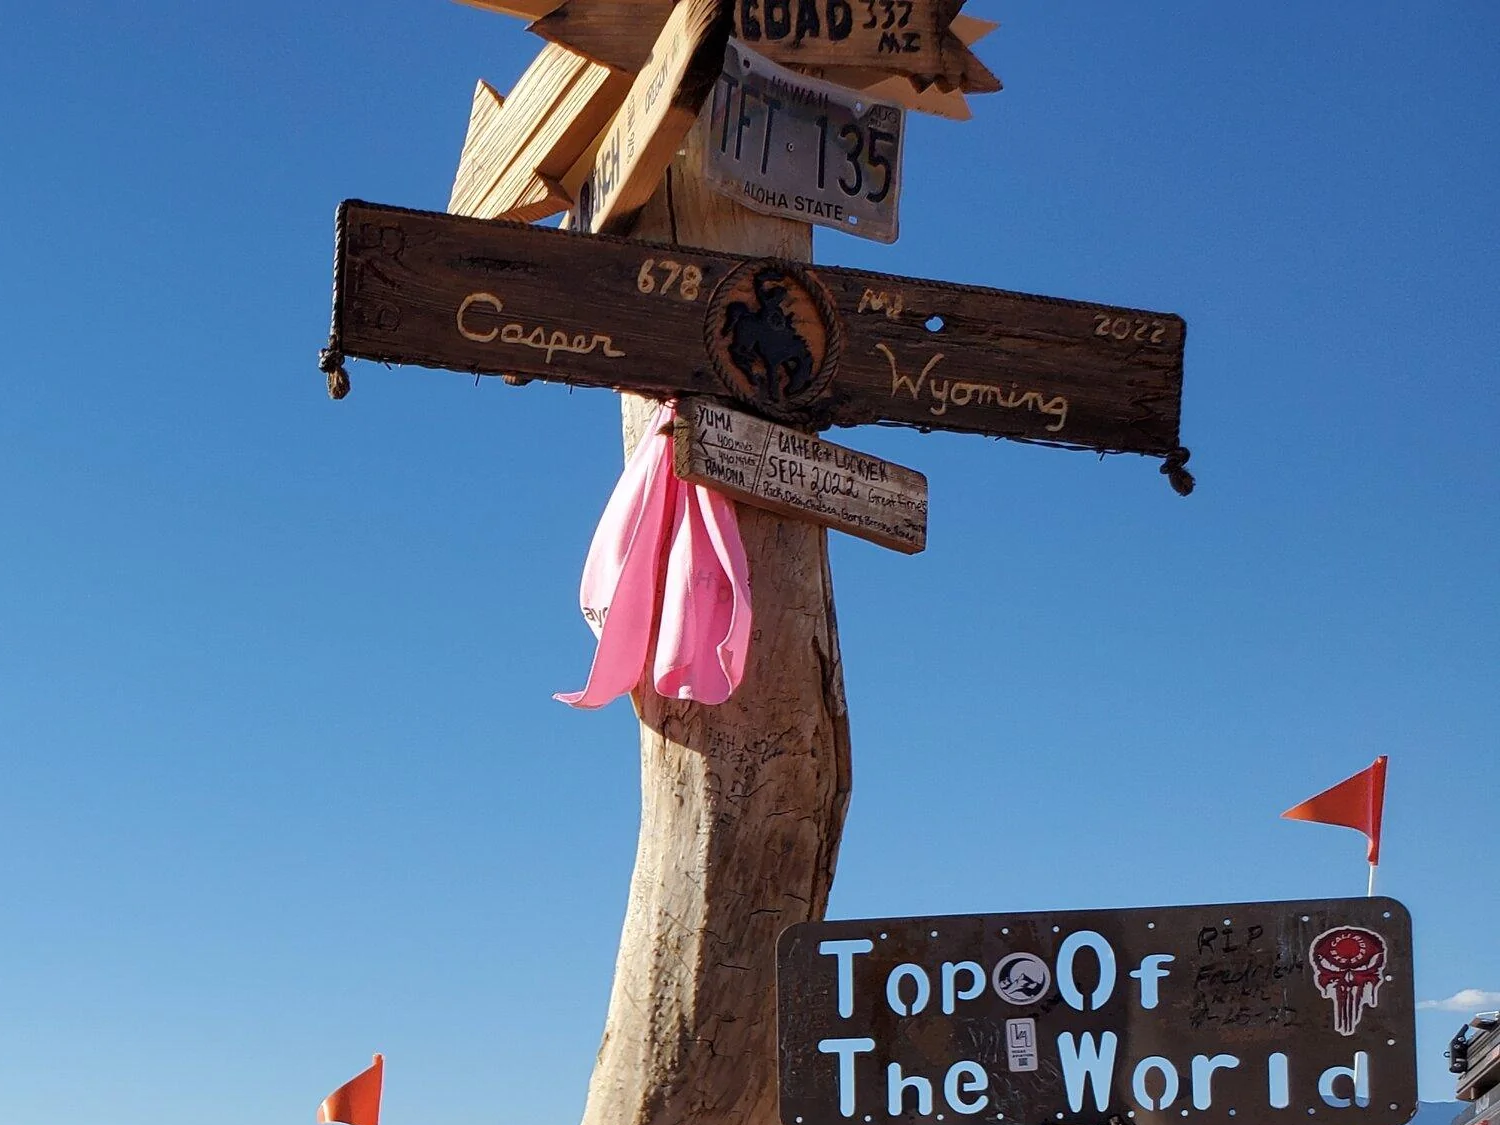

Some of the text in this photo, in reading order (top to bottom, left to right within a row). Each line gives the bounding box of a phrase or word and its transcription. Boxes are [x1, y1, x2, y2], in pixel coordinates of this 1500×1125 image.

[816, 115, 896, 203] 135
[743, 181, 843, 221] ALOHA STATE
[637, 258, 701, 301] 678
[1093, 313, 1167, 344] 2022
[456, 291, 1069, 432] Casper Wyoming
[697, 406, 733, 434] YUMA
[811, 466, 859, 500] 2022
[817, 929, 1176, 1020] Top Of
[817, 1030, 1370, 1117] The World
